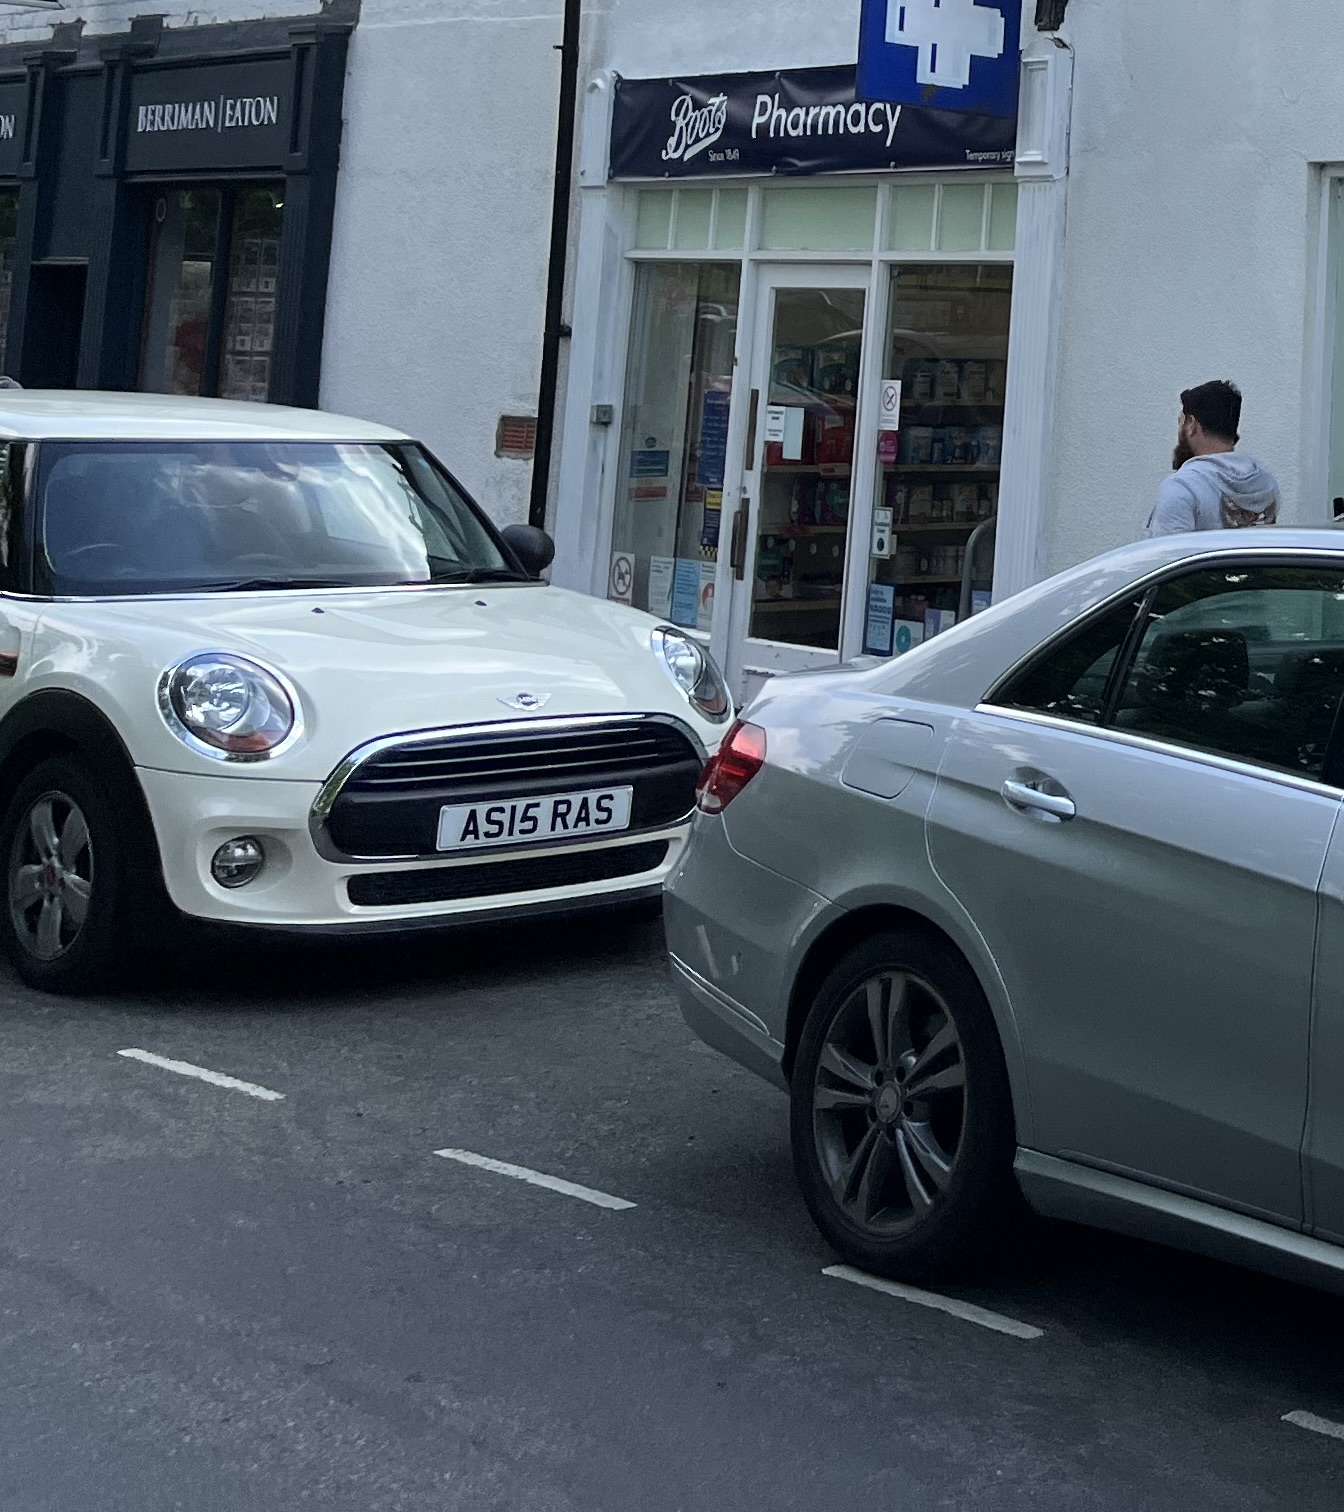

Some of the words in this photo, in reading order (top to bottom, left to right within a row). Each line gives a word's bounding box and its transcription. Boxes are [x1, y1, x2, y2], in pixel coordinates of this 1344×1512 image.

[137, 101, 215, 133] BERRIMAN
[225, 96, 278, 127] EATON
[662, 93, 728, 162] Boots
[752, 93, 901, 147] Pharmacy
[965, 149, 1001, 163] Temporary
[460, 802, 541, 842] AS15
[550, 793, 614, 832] RAS
